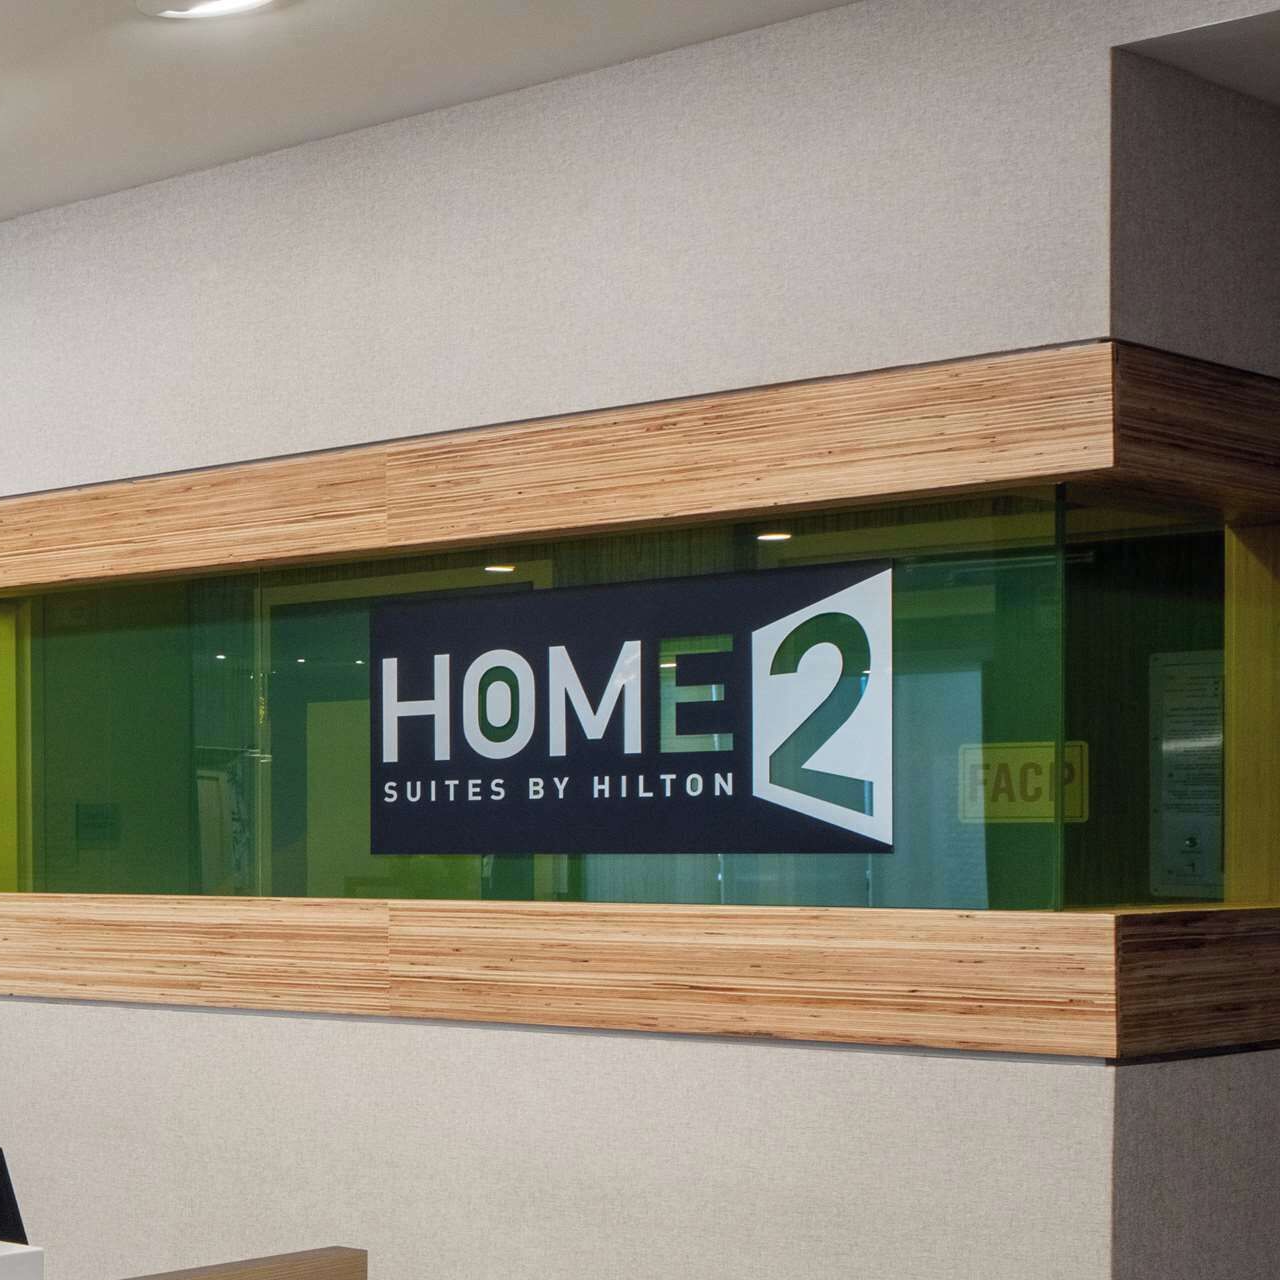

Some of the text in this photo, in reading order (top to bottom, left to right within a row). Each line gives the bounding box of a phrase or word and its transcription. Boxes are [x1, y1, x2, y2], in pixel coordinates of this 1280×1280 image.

[382, 611, 876, 817] HOME 2
[383, 772, 735, 803] SUITES BY HILTON
[968, 761, 1075, 804] FACP
